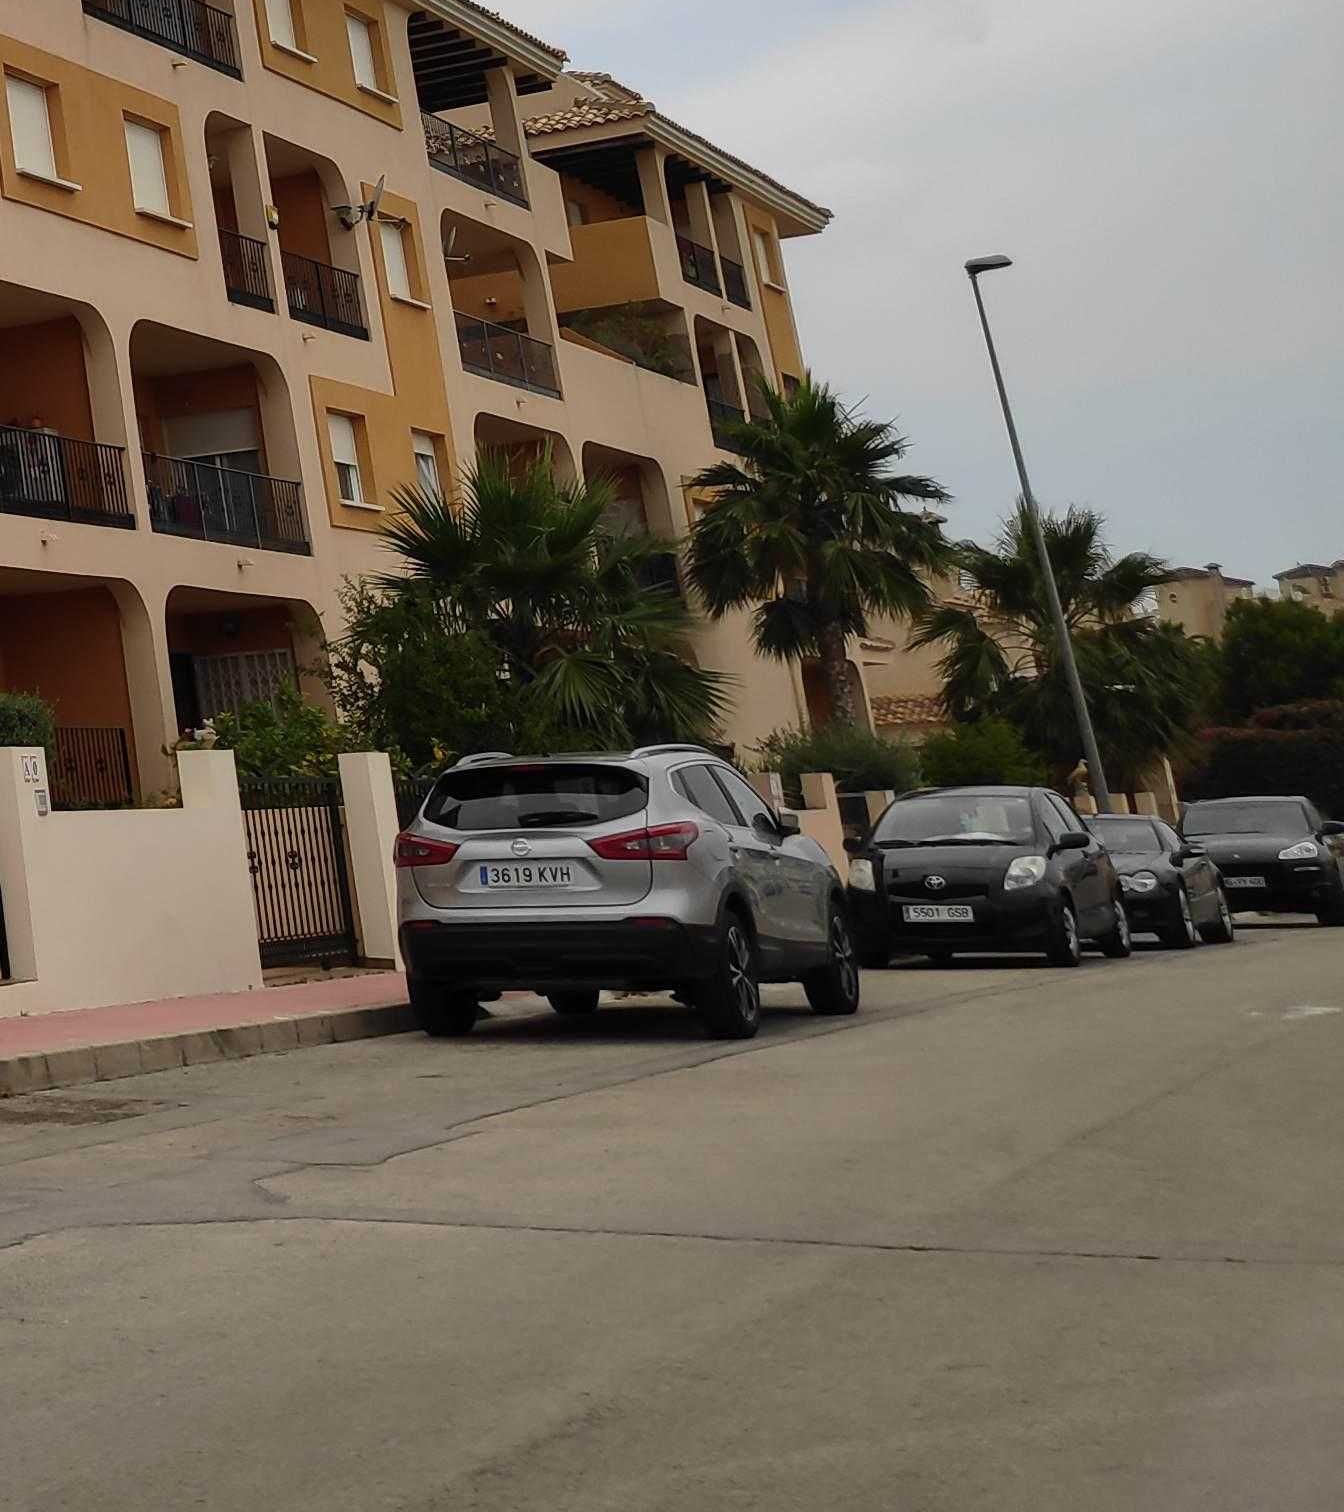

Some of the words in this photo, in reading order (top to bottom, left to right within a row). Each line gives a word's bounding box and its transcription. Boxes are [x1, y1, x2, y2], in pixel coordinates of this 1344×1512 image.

[490, 866, 533, 883] 3619
[538, 866, 571, 882] KVH
[947, 907, 969, 918] GSB
